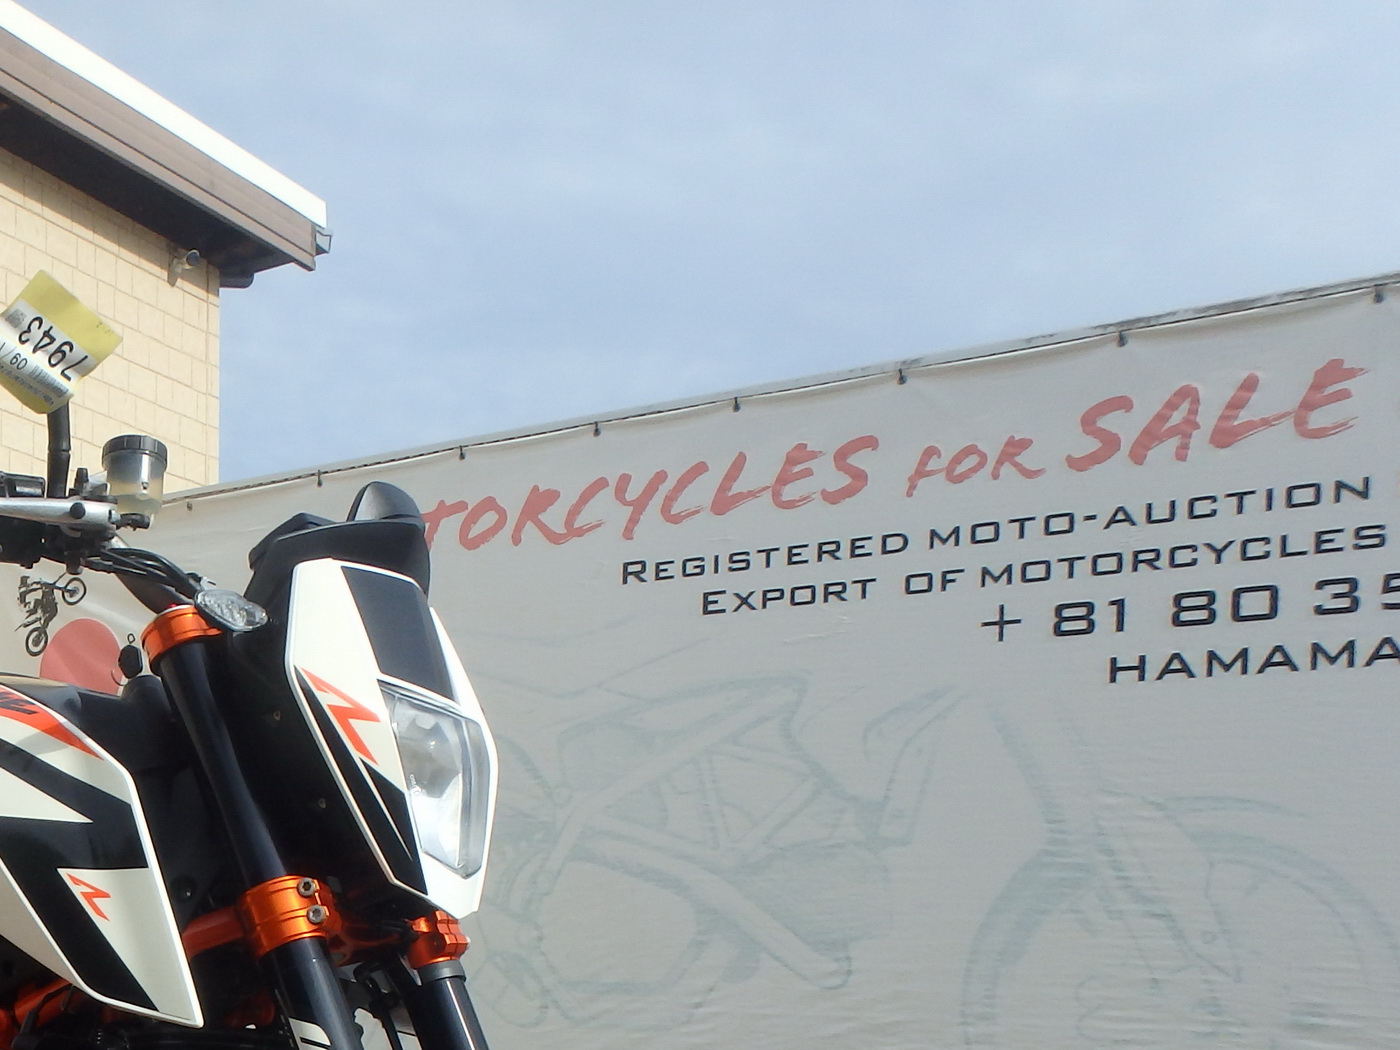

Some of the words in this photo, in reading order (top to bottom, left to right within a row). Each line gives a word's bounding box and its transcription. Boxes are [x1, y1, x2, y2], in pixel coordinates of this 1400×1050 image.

[18, 316, 88, 382] 7943
[421, 435, 880, 551] TORCYCLES
[1065, 358, 1371, 473] SALE
[621, 532, 909, 585] REGISTERED
[929, 475, 1371, 551] MOTO-AUCTION
[702, 577, 877, 616] EXPORT
[904, 568, 966, 595] OF
[980, 524, 1387, 588] MOTORCYCLES
[1053, 597, 1126, 637] 81
[1171, 583, 1280, 627] 80
